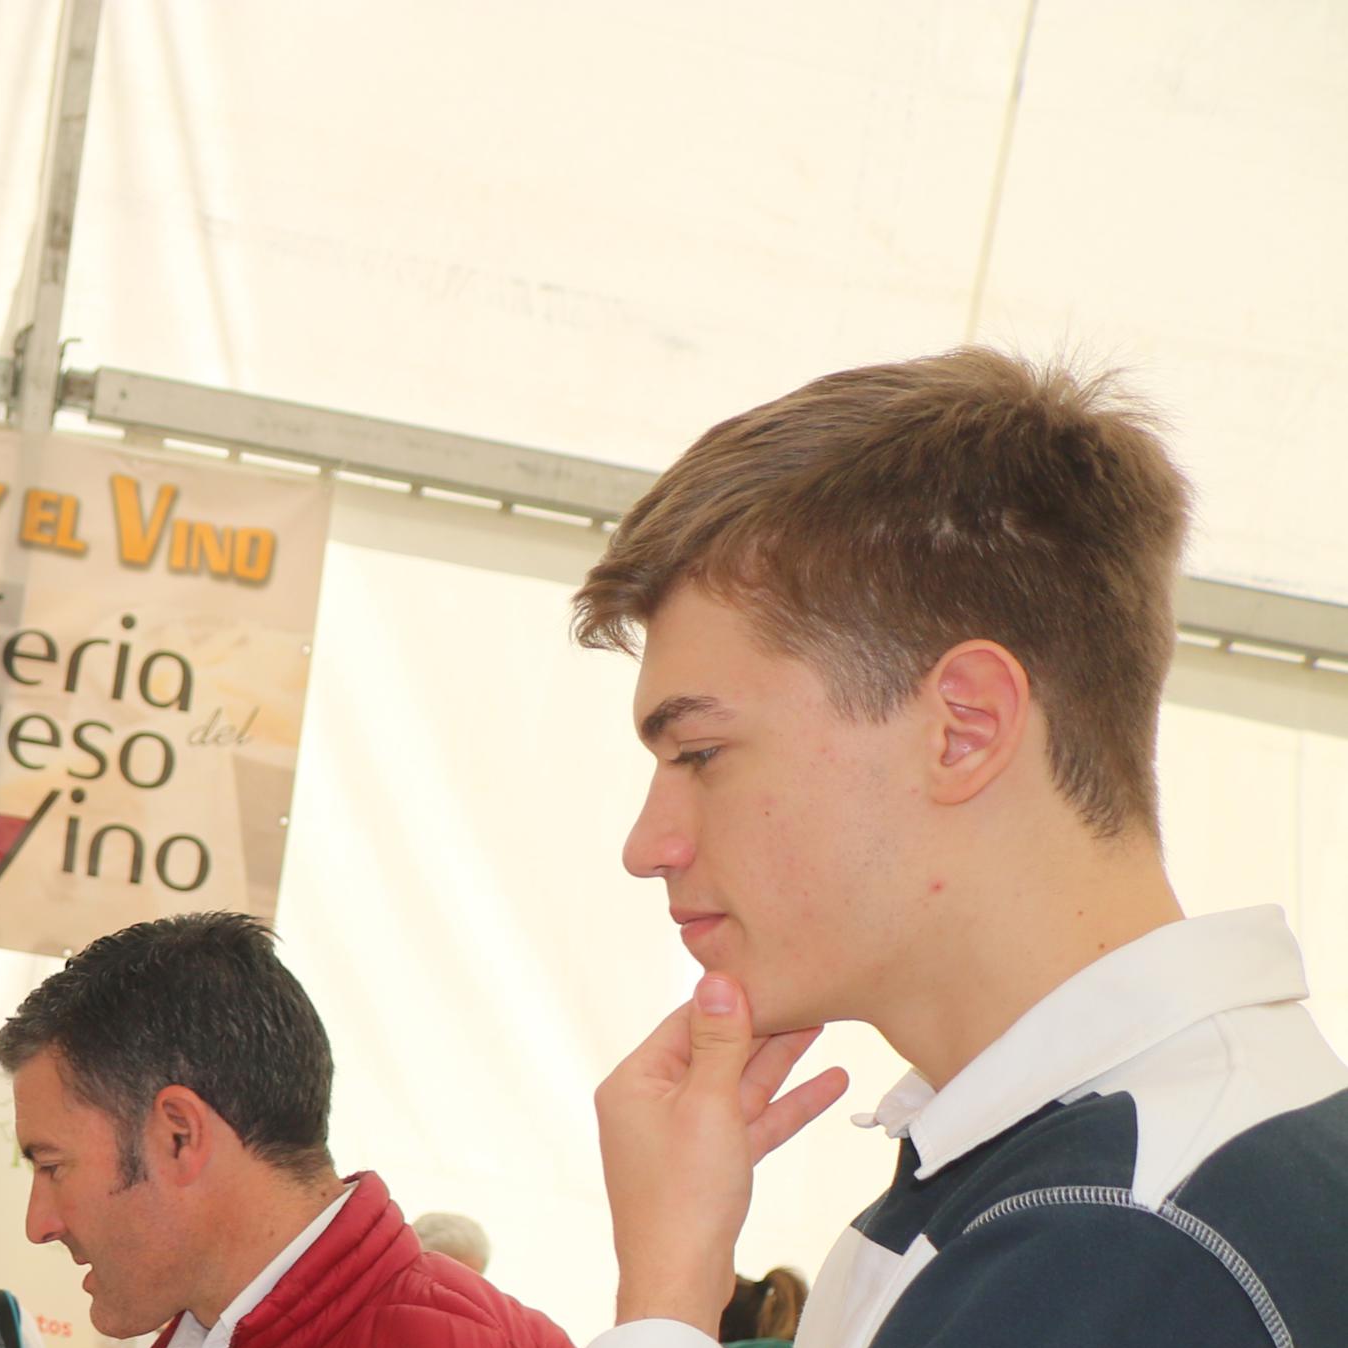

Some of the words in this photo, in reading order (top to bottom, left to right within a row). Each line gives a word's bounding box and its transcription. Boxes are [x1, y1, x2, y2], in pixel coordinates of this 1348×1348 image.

[19, 487, 88, 556] EL
[110, 473, 276, 584] VINO
[187, 706, 261, 748] del
